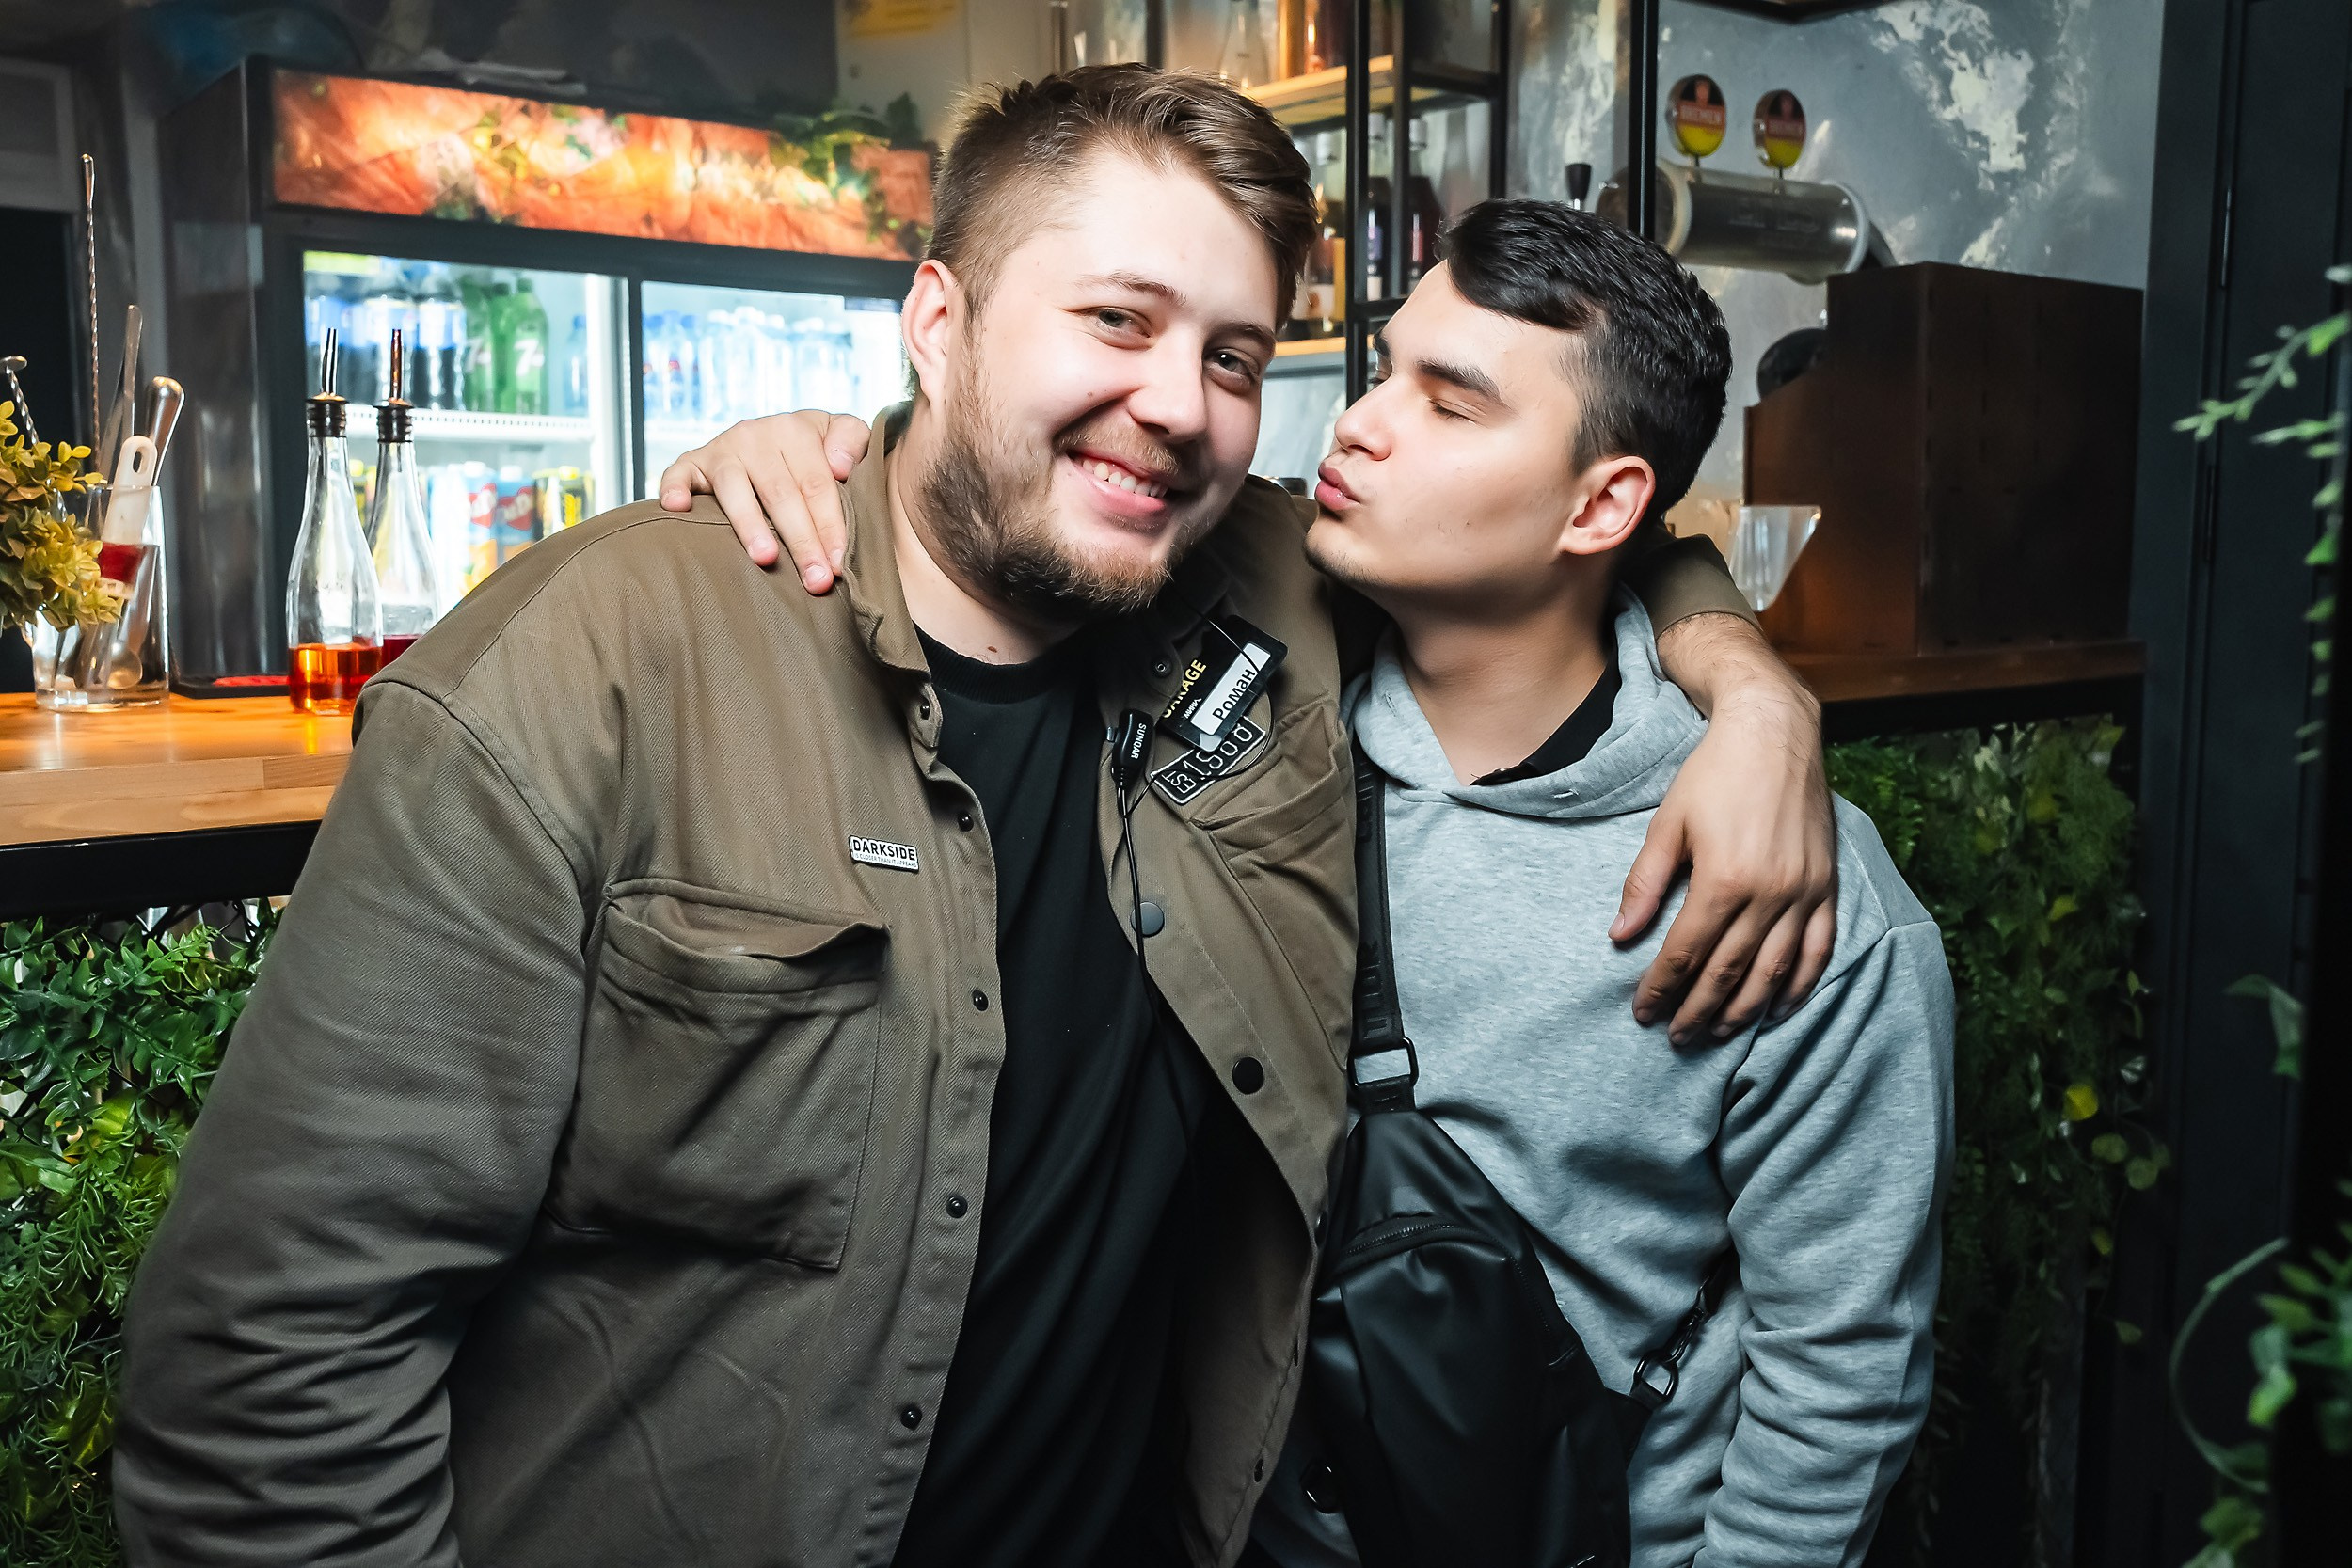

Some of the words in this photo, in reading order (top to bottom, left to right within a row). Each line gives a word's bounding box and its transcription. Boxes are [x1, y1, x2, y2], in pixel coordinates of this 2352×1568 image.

[1212, 669, 1256, 721] Роман
[1130, 722, 1147, 760] SUNQAR
[1161, 770, 1198, 794] EST
[852, 839, 916, 861] DARKSIDE
